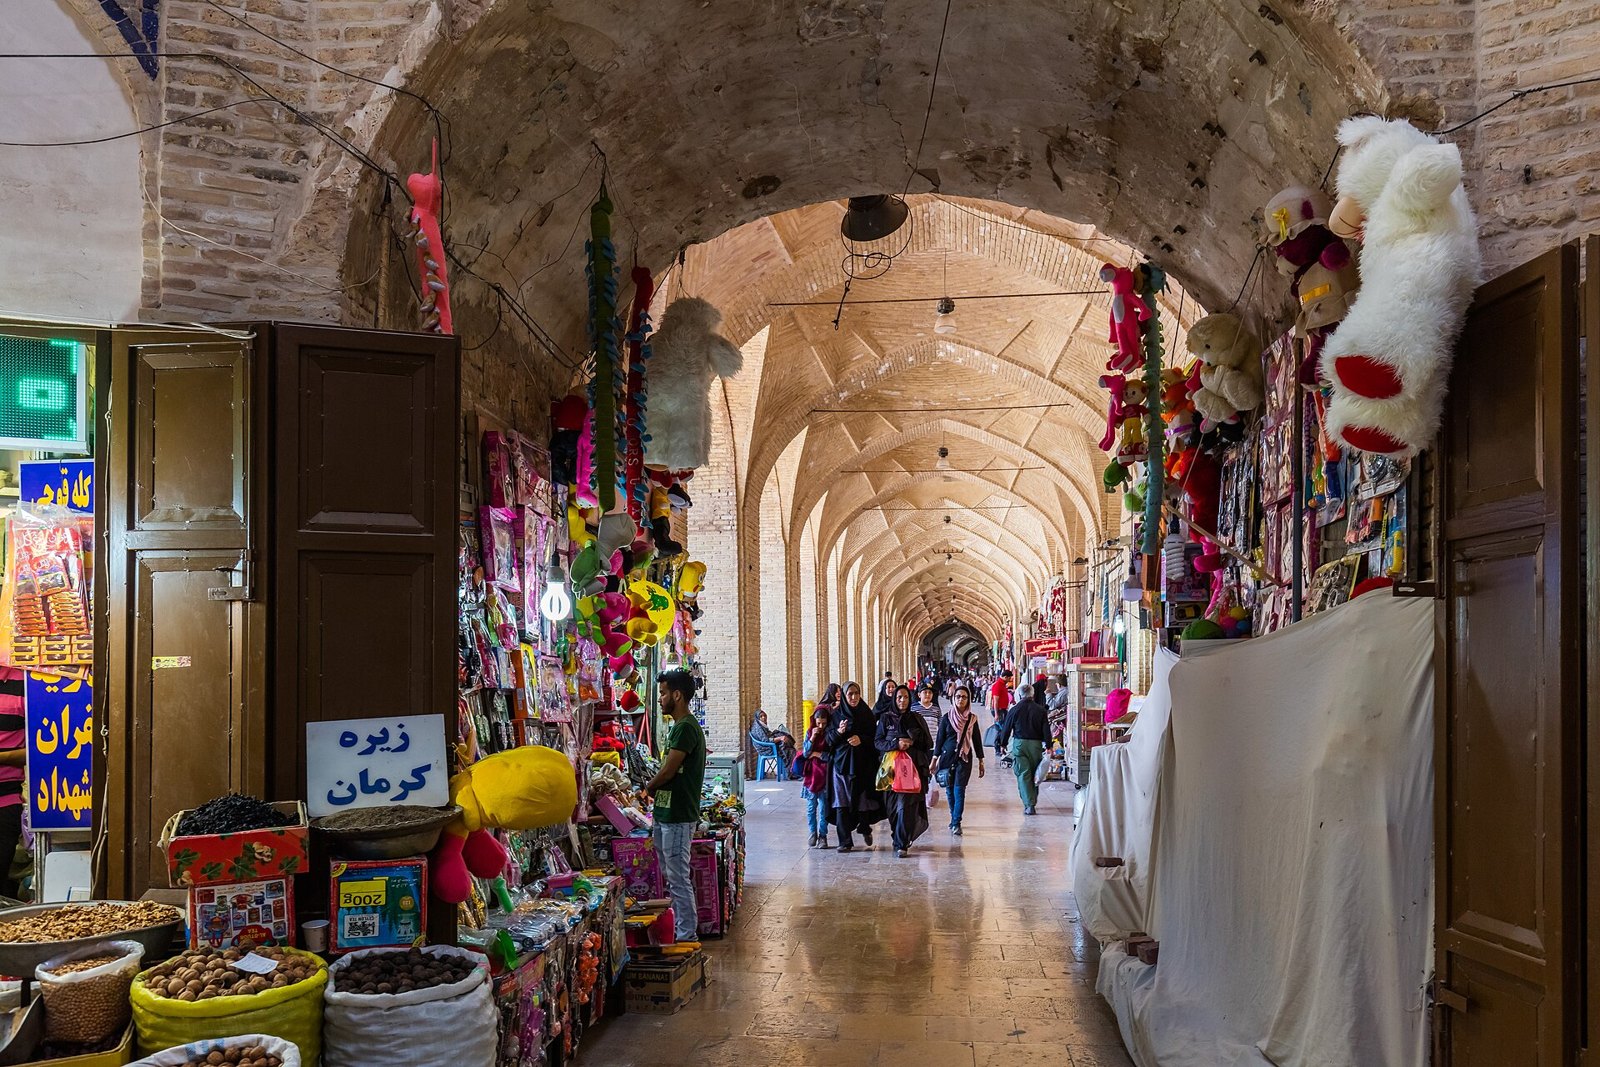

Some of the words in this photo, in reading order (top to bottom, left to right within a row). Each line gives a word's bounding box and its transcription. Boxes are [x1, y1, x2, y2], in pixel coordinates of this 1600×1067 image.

[72, 469, 91, 508] کله
[1032, 640, 1059, 652] بستنی
[36, 703, 93, 759] فران
[339, 723, 410, 756] زیره
[326, 763, 432, 806] کرمان
[343, 893, 382, 906] 200g
